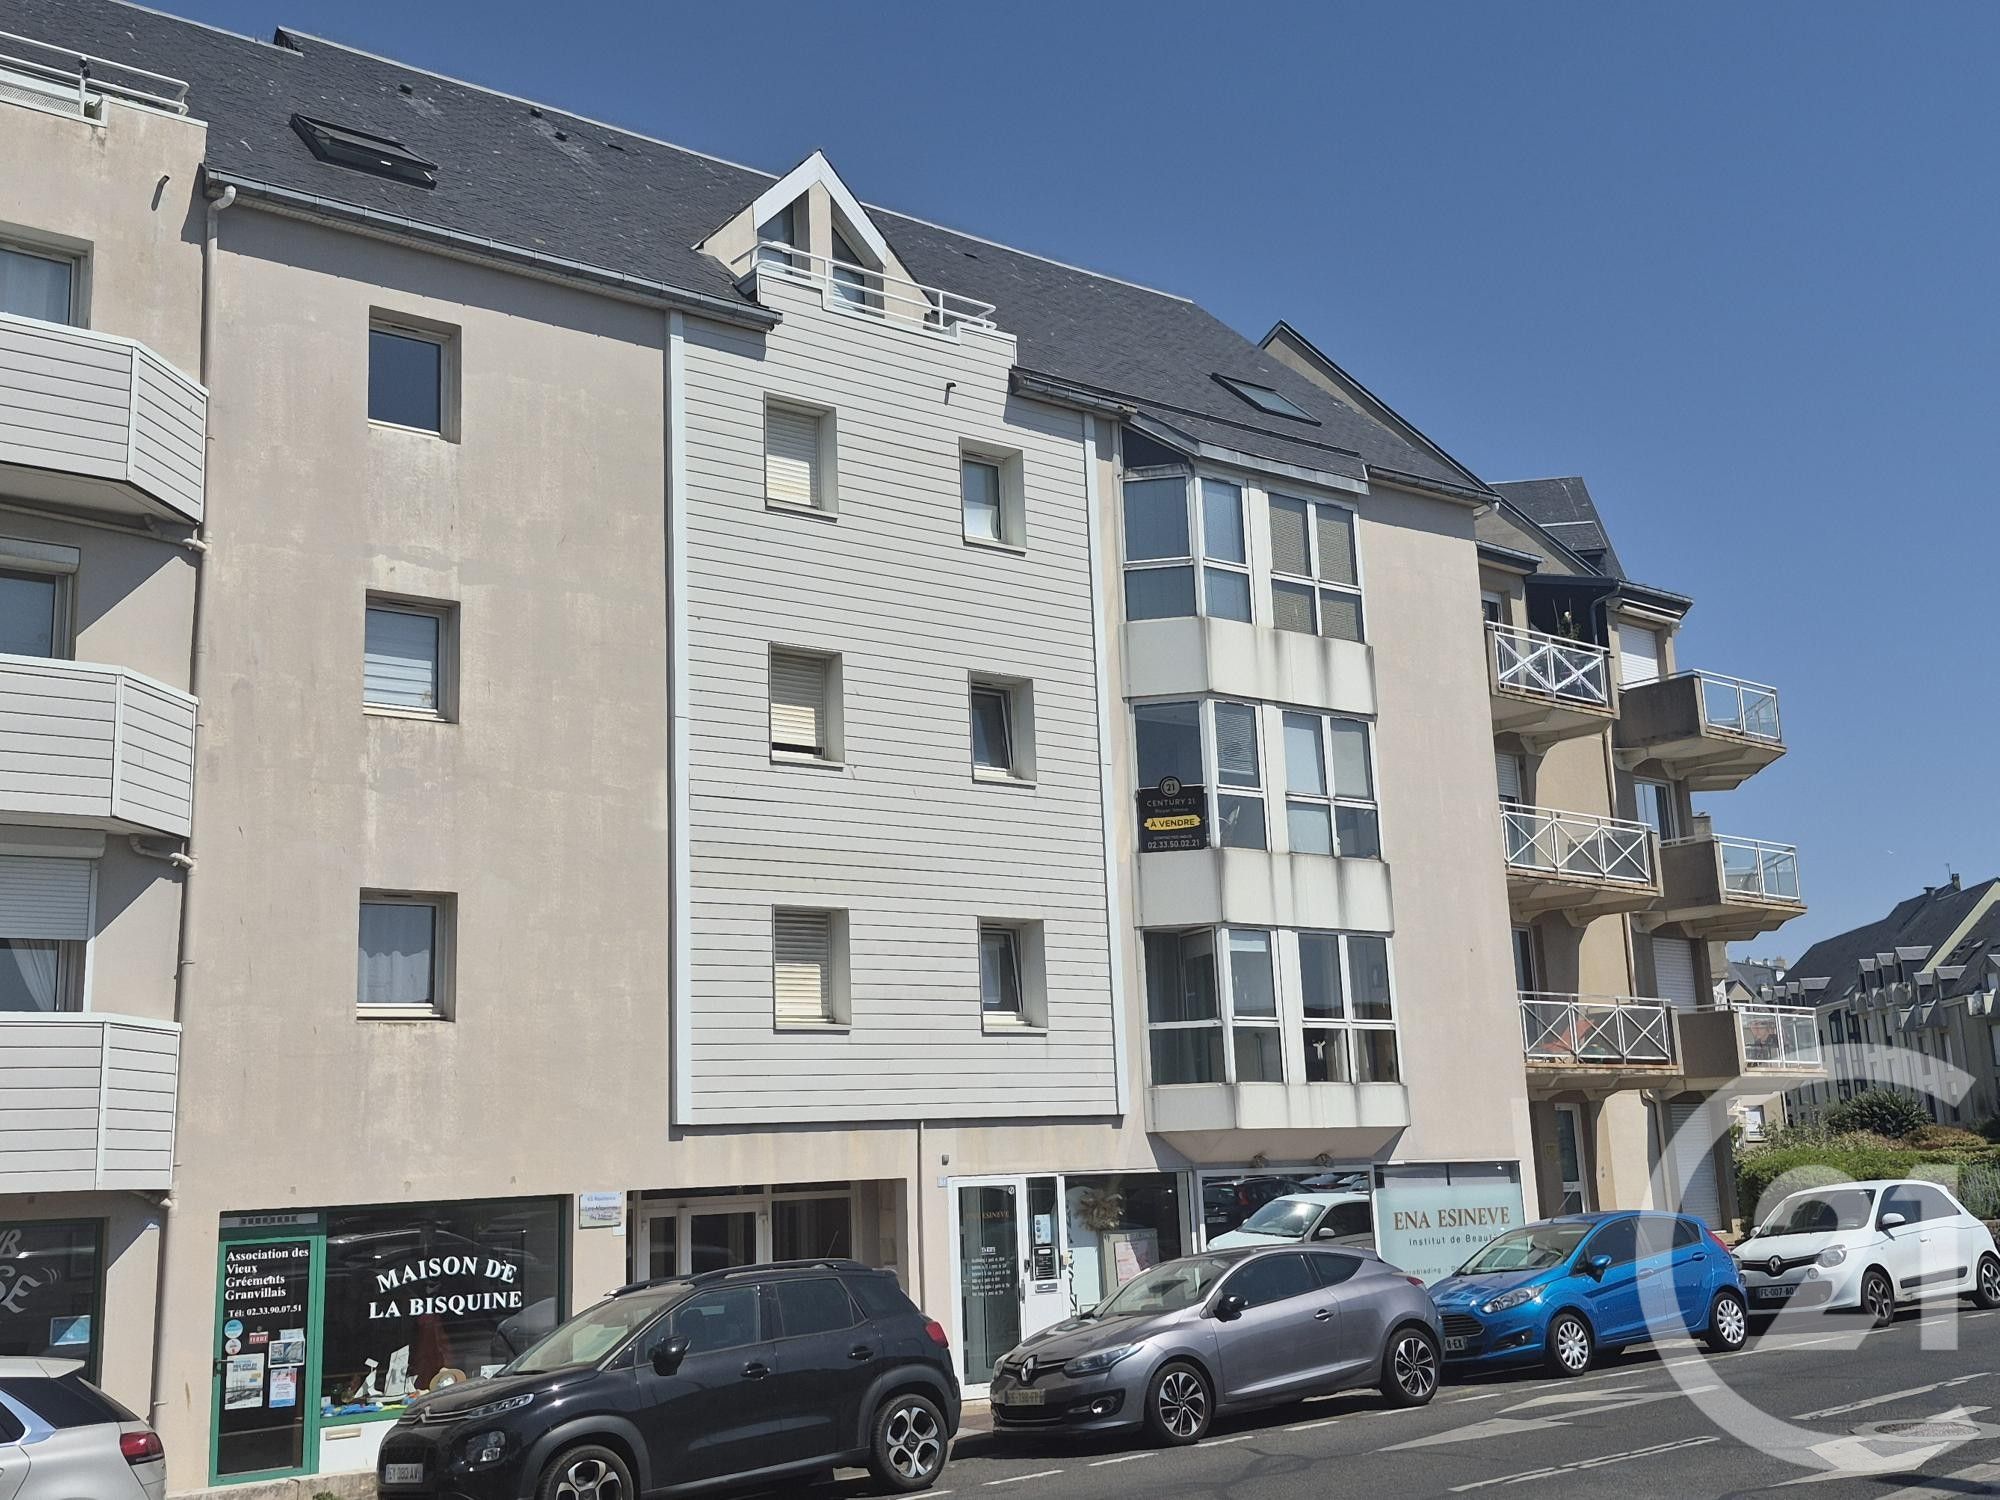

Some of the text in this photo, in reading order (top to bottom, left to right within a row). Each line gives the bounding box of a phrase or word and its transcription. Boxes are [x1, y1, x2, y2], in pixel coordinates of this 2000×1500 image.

[1166, 783, 1175, 792] 21
[1146, 798, 1186, 807] CENTURY
[1160, 818, 1195, 828] VENDRE
[1394, 1206, 1511, 1230] ENA ESINEVE
[1450, 1235, 1461, 1244] de
[227, 1247, 309, 1261] Association des
[226, 1264, 258, 1274] Vieux
[376, 1256, 517, 1294] MAISON DE
[226, 1275, 285, 1288] Gréements
[225, 1287, 286, 1300] Granvillais
[228, 1304, 302, 1318] Tél: 02.33.90.07.51
[368, 1291, 522, 1319] LA BISQUINE
